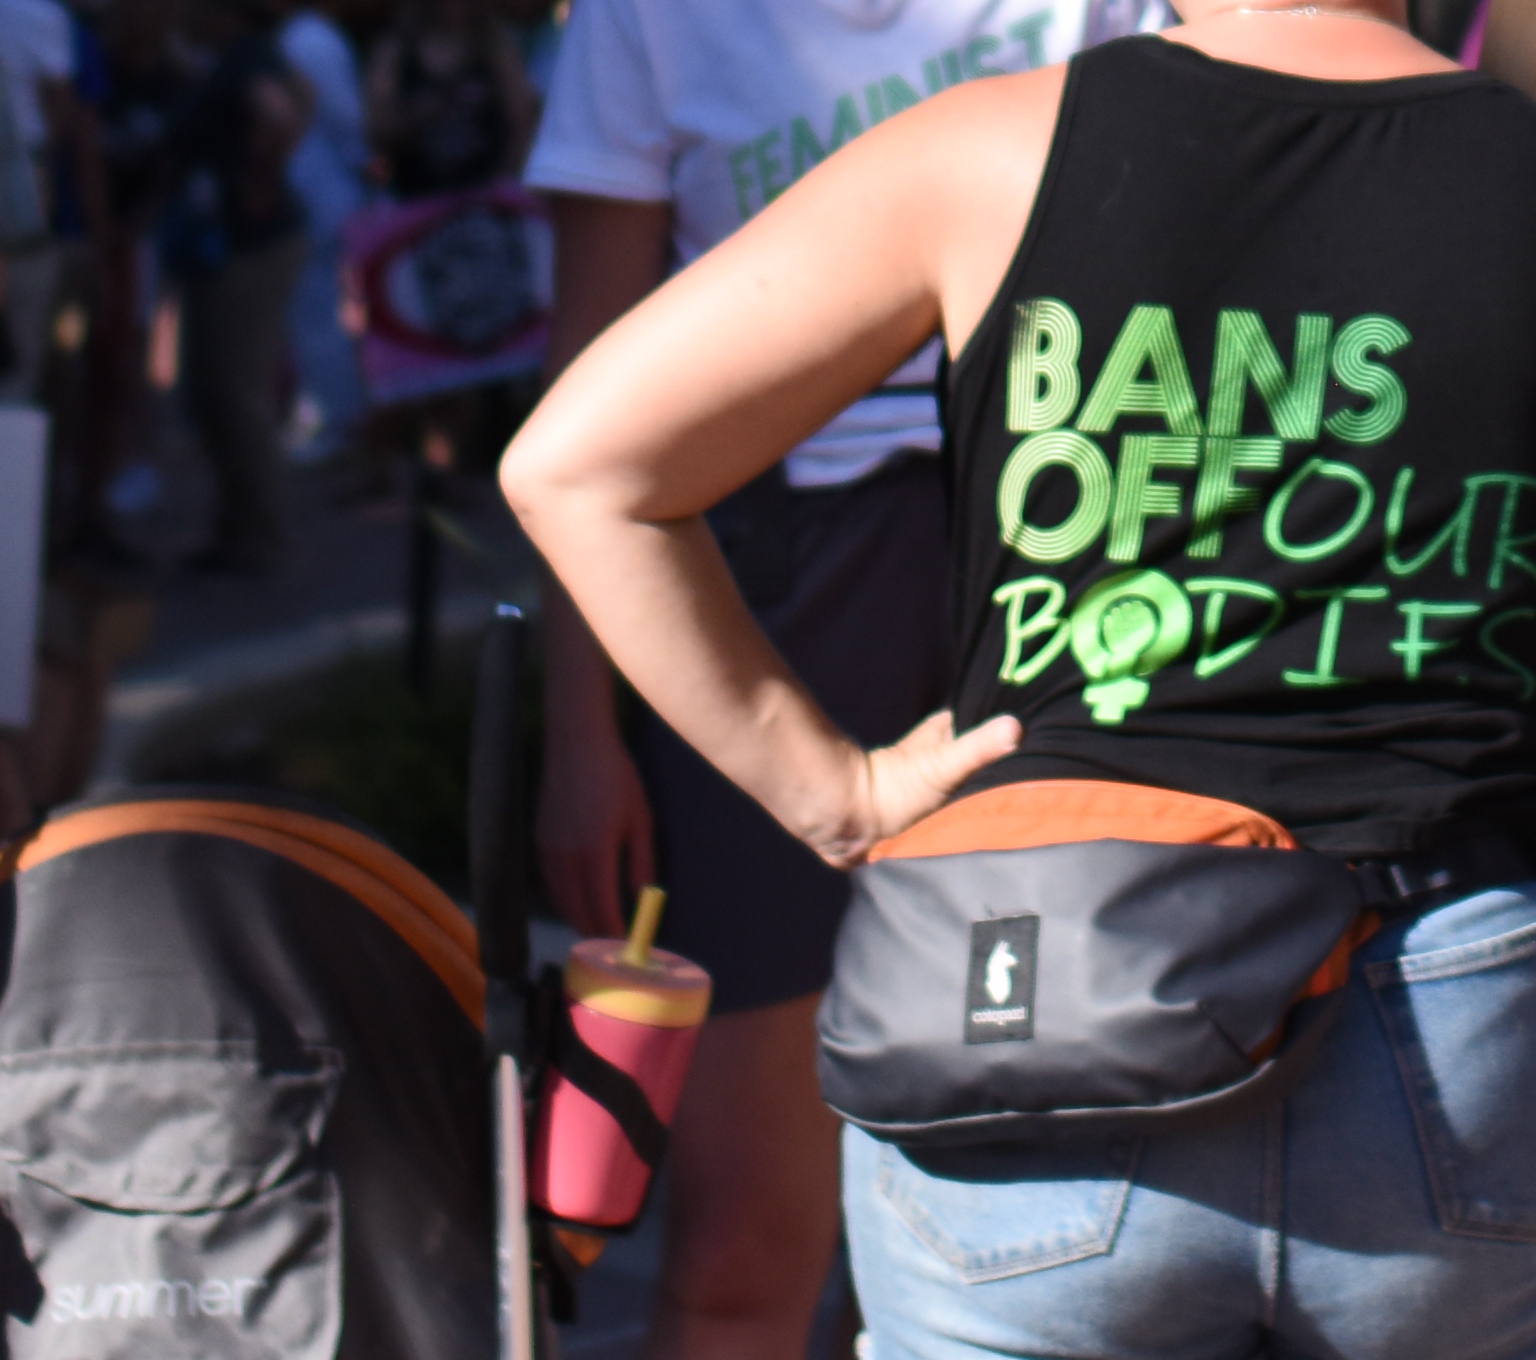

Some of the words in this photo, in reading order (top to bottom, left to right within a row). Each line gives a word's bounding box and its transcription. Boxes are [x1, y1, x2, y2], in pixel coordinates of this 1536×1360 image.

[726, 12, 1055, 221] FEMINIST
[1005, 296, 1413, 444] BANS
[996, 427, 1285, 562] OFF
[52, 1277, 256, 1323] summer
